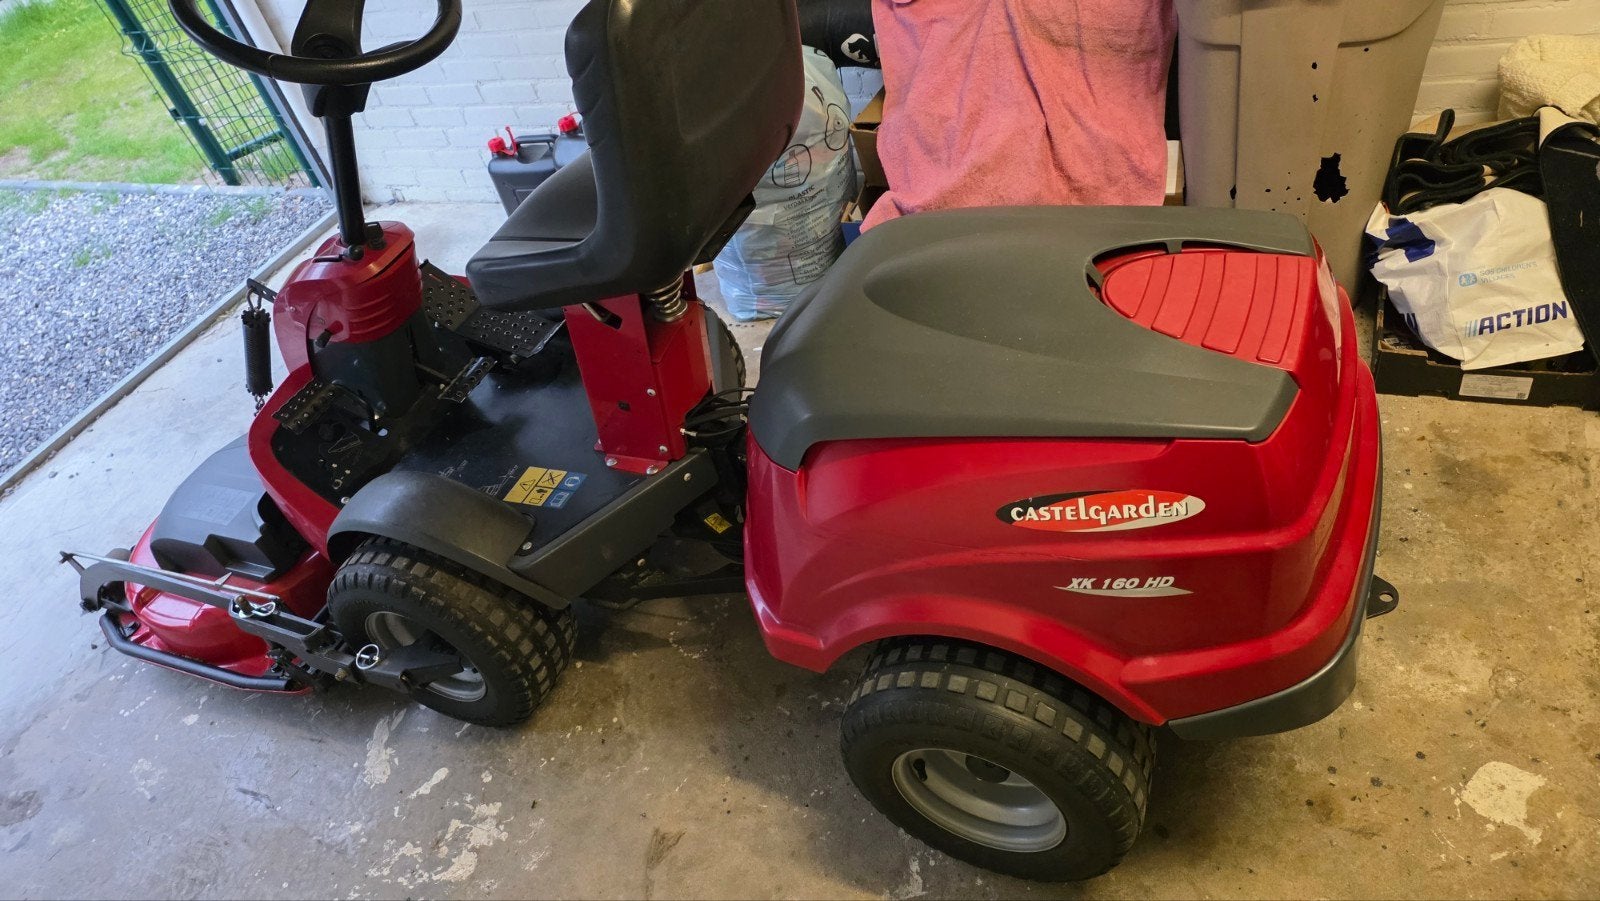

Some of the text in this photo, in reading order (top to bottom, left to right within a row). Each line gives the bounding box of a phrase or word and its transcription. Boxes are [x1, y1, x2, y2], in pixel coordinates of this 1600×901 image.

[1478, 300, 1568, 336] ACTION
[1066, 576, 1175, 590] XK 160 HD
